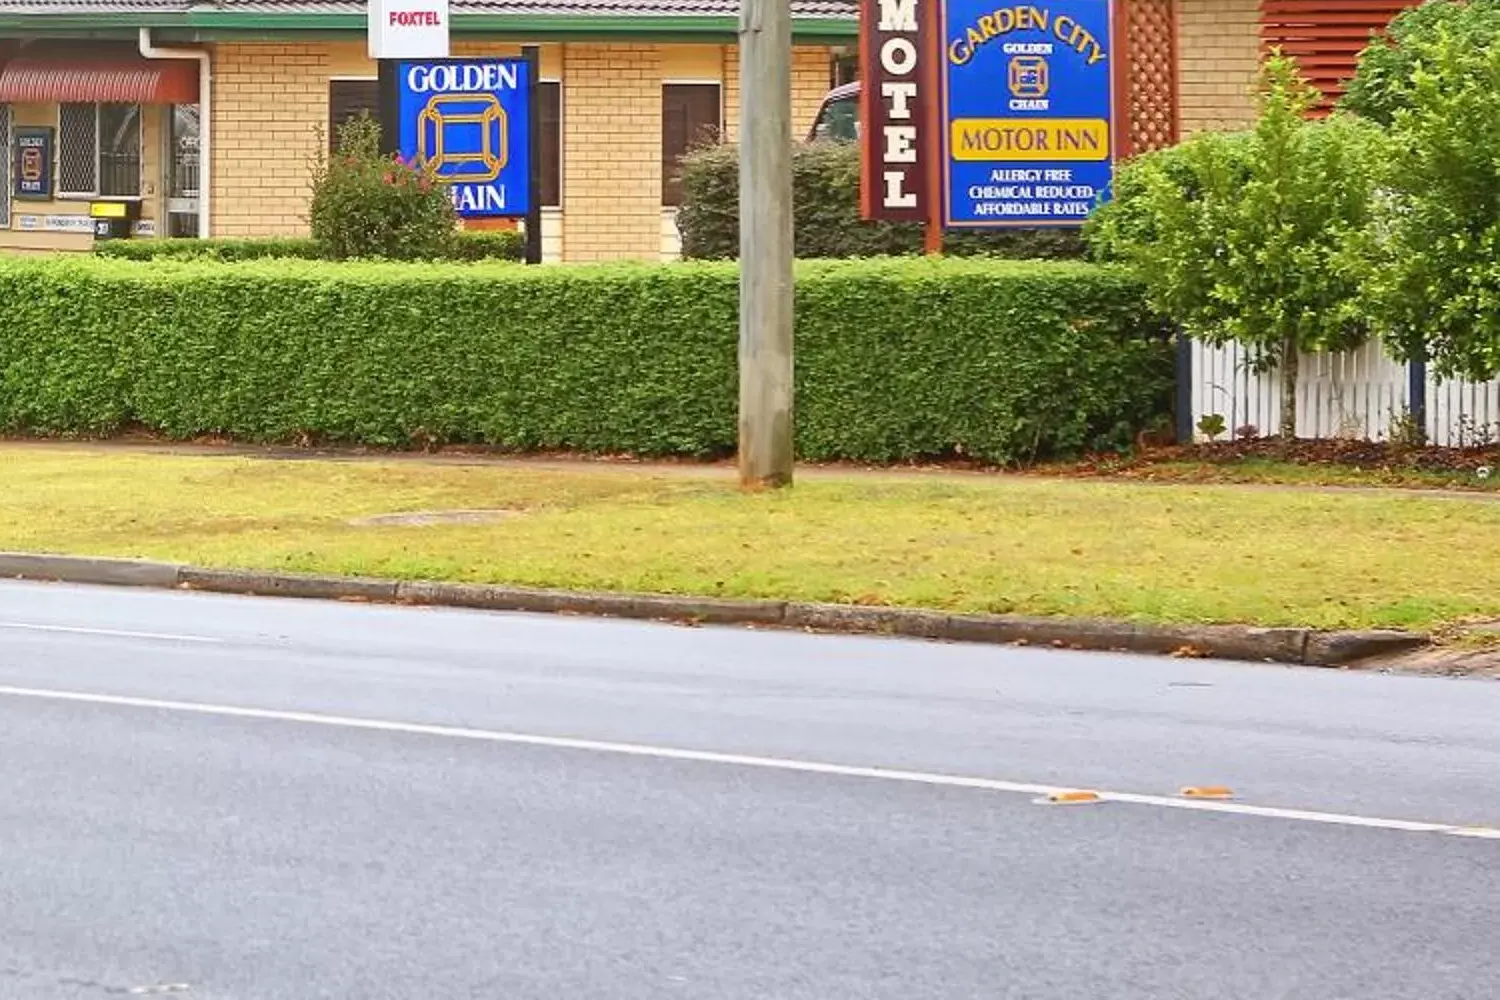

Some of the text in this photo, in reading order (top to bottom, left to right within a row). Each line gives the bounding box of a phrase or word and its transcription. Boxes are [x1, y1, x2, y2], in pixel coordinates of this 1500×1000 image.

[389, 11, 441, 26] FOXTEL
[949, 5, 1107, 66] GARDEN CITY
[1003, 43, 1053, 54] GOLDEN
[408, 63, 517, 93] GOLDEN
[1008, 99, 1049, 110] CHAIN
[961, 127, 1099, 151] MOTOR INN
[990, 169, 1073, 181] ALLERGY FREE
[451, 184, 505, 211] AIN
[969, 185, 1094, 199] CHEMICAL REDUCED
[974, 202, 1089, 215] AFFORDABLE RATES
